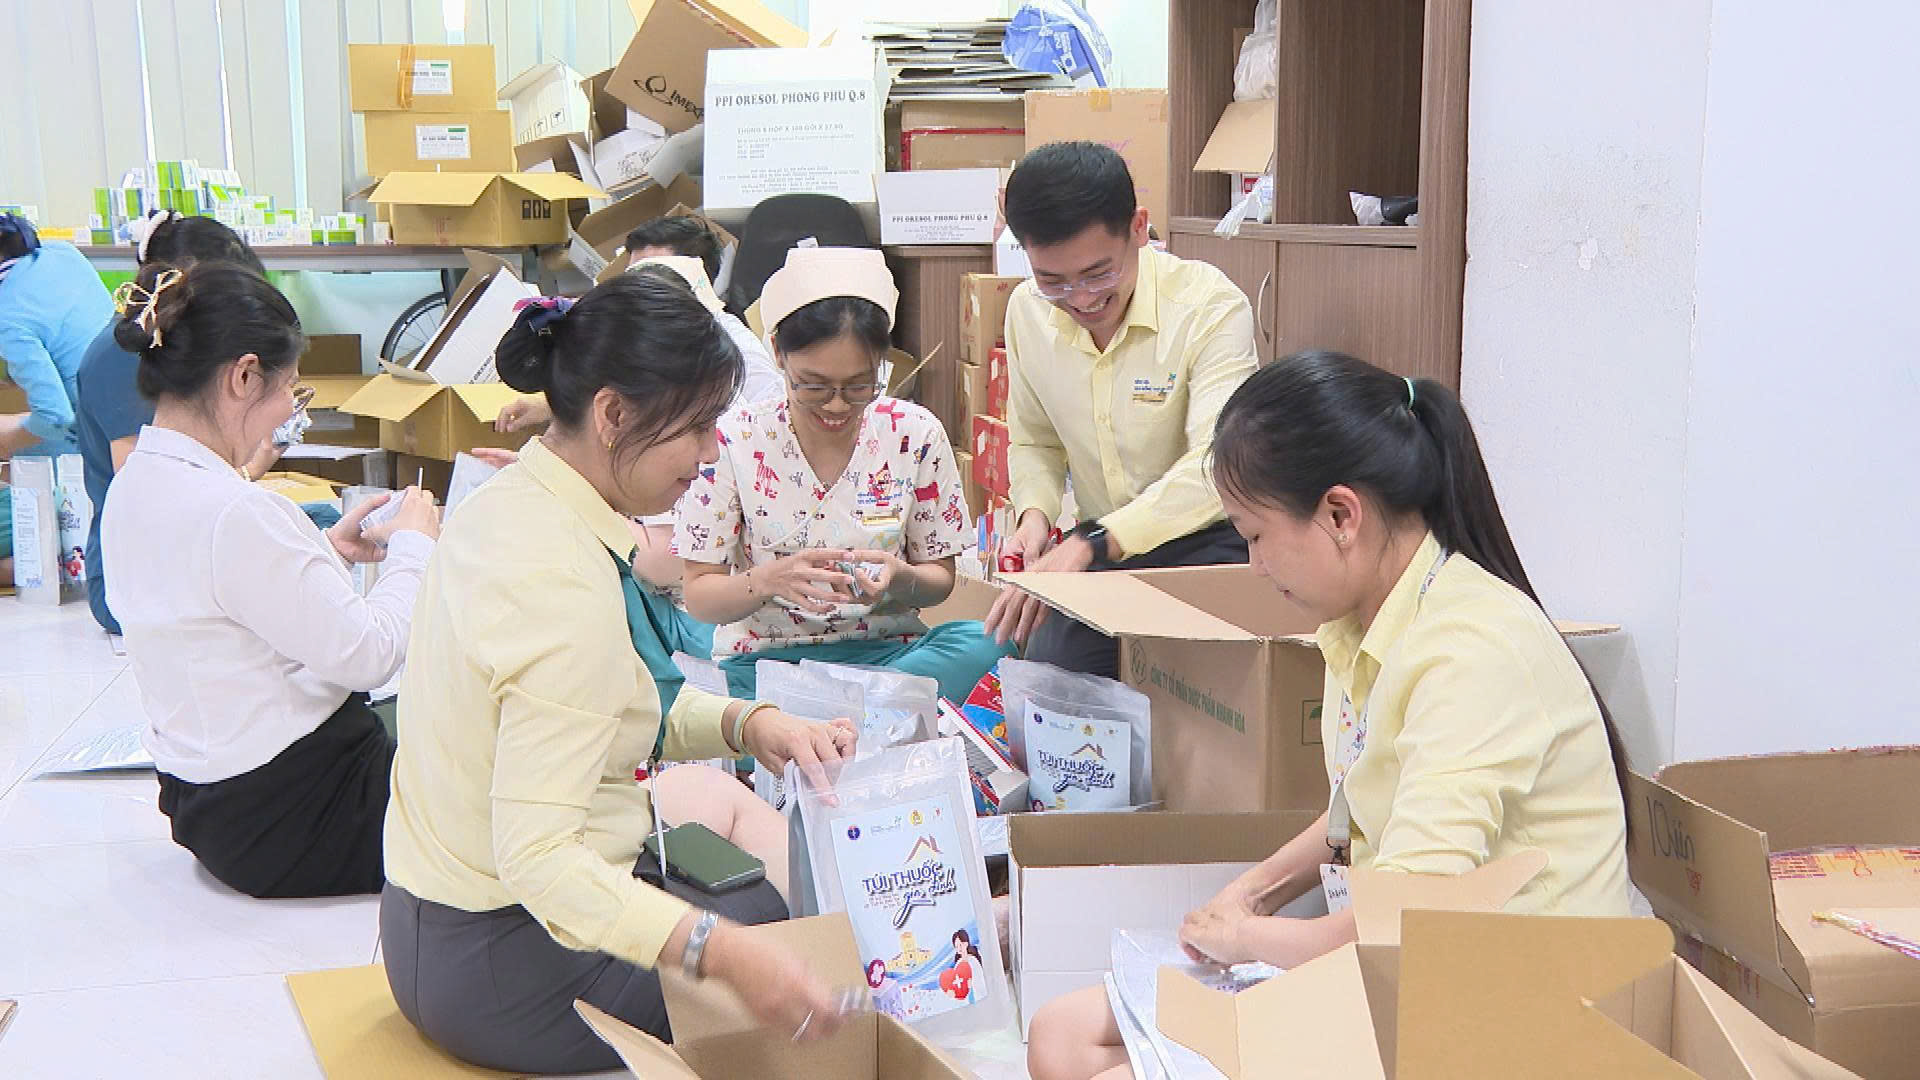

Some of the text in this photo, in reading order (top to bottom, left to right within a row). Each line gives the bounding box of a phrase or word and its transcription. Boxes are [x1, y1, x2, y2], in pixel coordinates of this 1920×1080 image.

[671, 89, 704, 119] IMEX
[715, 95, 733, 107] PPI
[736, 93, 779, 106] ORESOL
[782, 91, 820, 104] PHONG
[849, 89, 866, 103] Q.8
[905, 215, 933, 223] ORESOL
[934, 214, 959, 222] PHONG
[862, 859, 943, 895] TÚI THUỐC
[893, 889, 926, 930] gia
